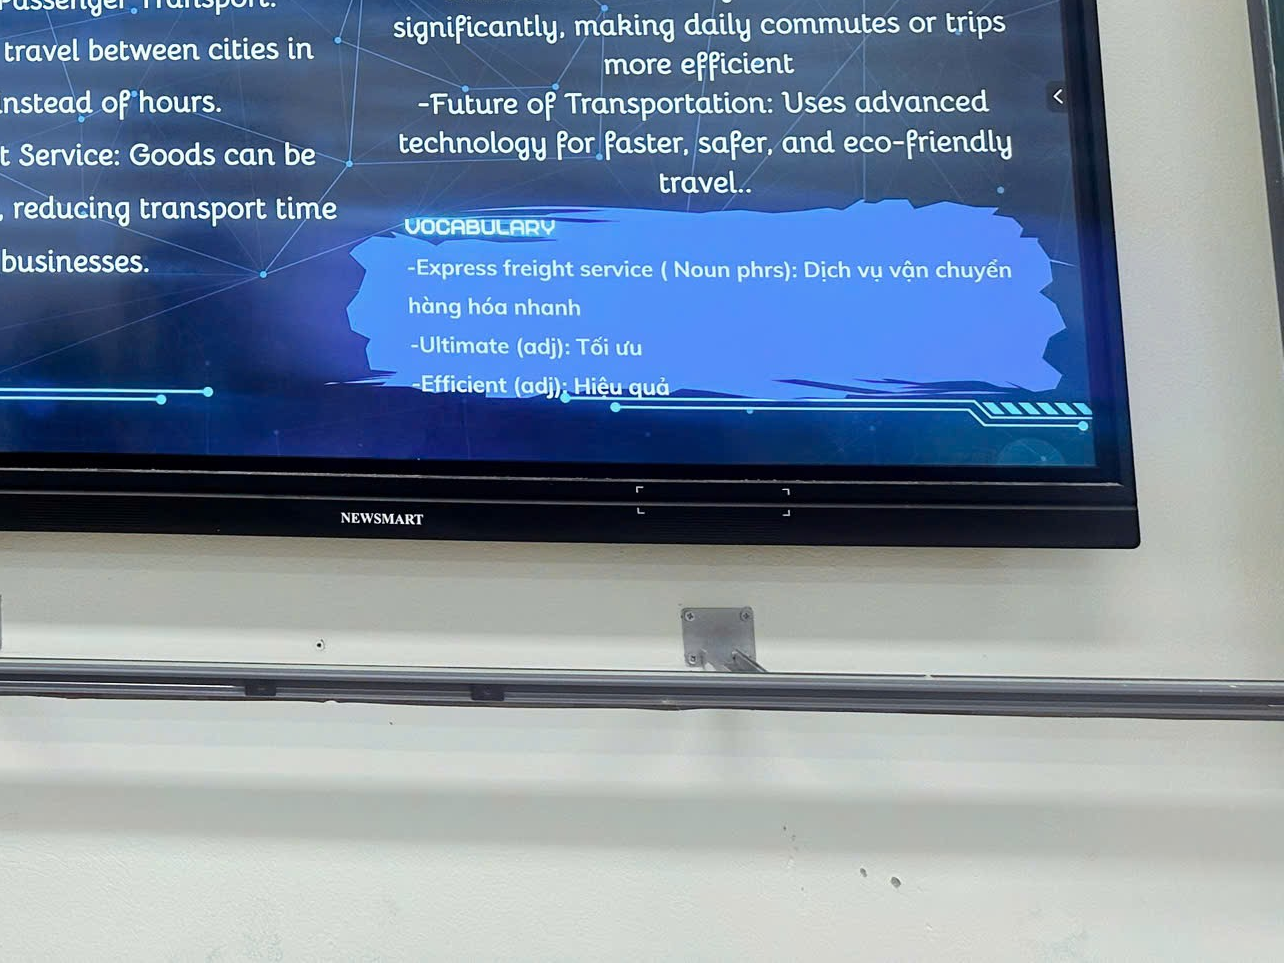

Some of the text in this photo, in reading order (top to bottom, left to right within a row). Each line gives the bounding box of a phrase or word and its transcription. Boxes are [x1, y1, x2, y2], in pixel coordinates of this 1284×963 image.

[392, 11, 1006, 45] significantly, making daily commutes or trips
[4, 39, 79, 62] travel
[88, 38, 200, 61] between
[208, 37, 279, 60] cities
[287, 36, 314, 59] in
[603, 52, 794, 82] more efficient
[101, 90, 132, 120] of
[138, 90, 222, 113] hours.
[417, 89, 989, 122] -Future of Transportation: Uses advanced
[19, 143, 121, 167] Service:
[129, 143, 216, 166] Goods
[224, 146, 274, 165] can
[284, 142, 316, 165] be
[398, 129, 1013, 161] technology for faster, safer, and eco-friendly
[659, 170, 752, 195] travel..
[13, 197, 131, 225] reducing
[139, 197, 268, 224] transport
[276, 196, 337, 219] time
[404, 217, 556, 236] VOCABULARY
[1, 249, 149, 274] businesses.
[407, 258, 498, 282] -Express
[502, 258, 574, 283] freight
[580, 260, 654, 279] service
[674, 260, 731, 279] Noun
[736, 258, 799, 283] phrs):
[804, 259, 851, 284] Dịch
[857, 264, 883, 285] vụ
[888, 259, 930, 284] vận
[935, 258, 1012, 284] chuyển
[408, 297, 581, 320] hàng hóa nhanh
[411, 335, 643, 360] -Ultimate (adj): Tối ưu
[412, 374, 670, 399] -Efficient (adj): Hiệu quả
[340, 511, 424, 526] NEWSMART
